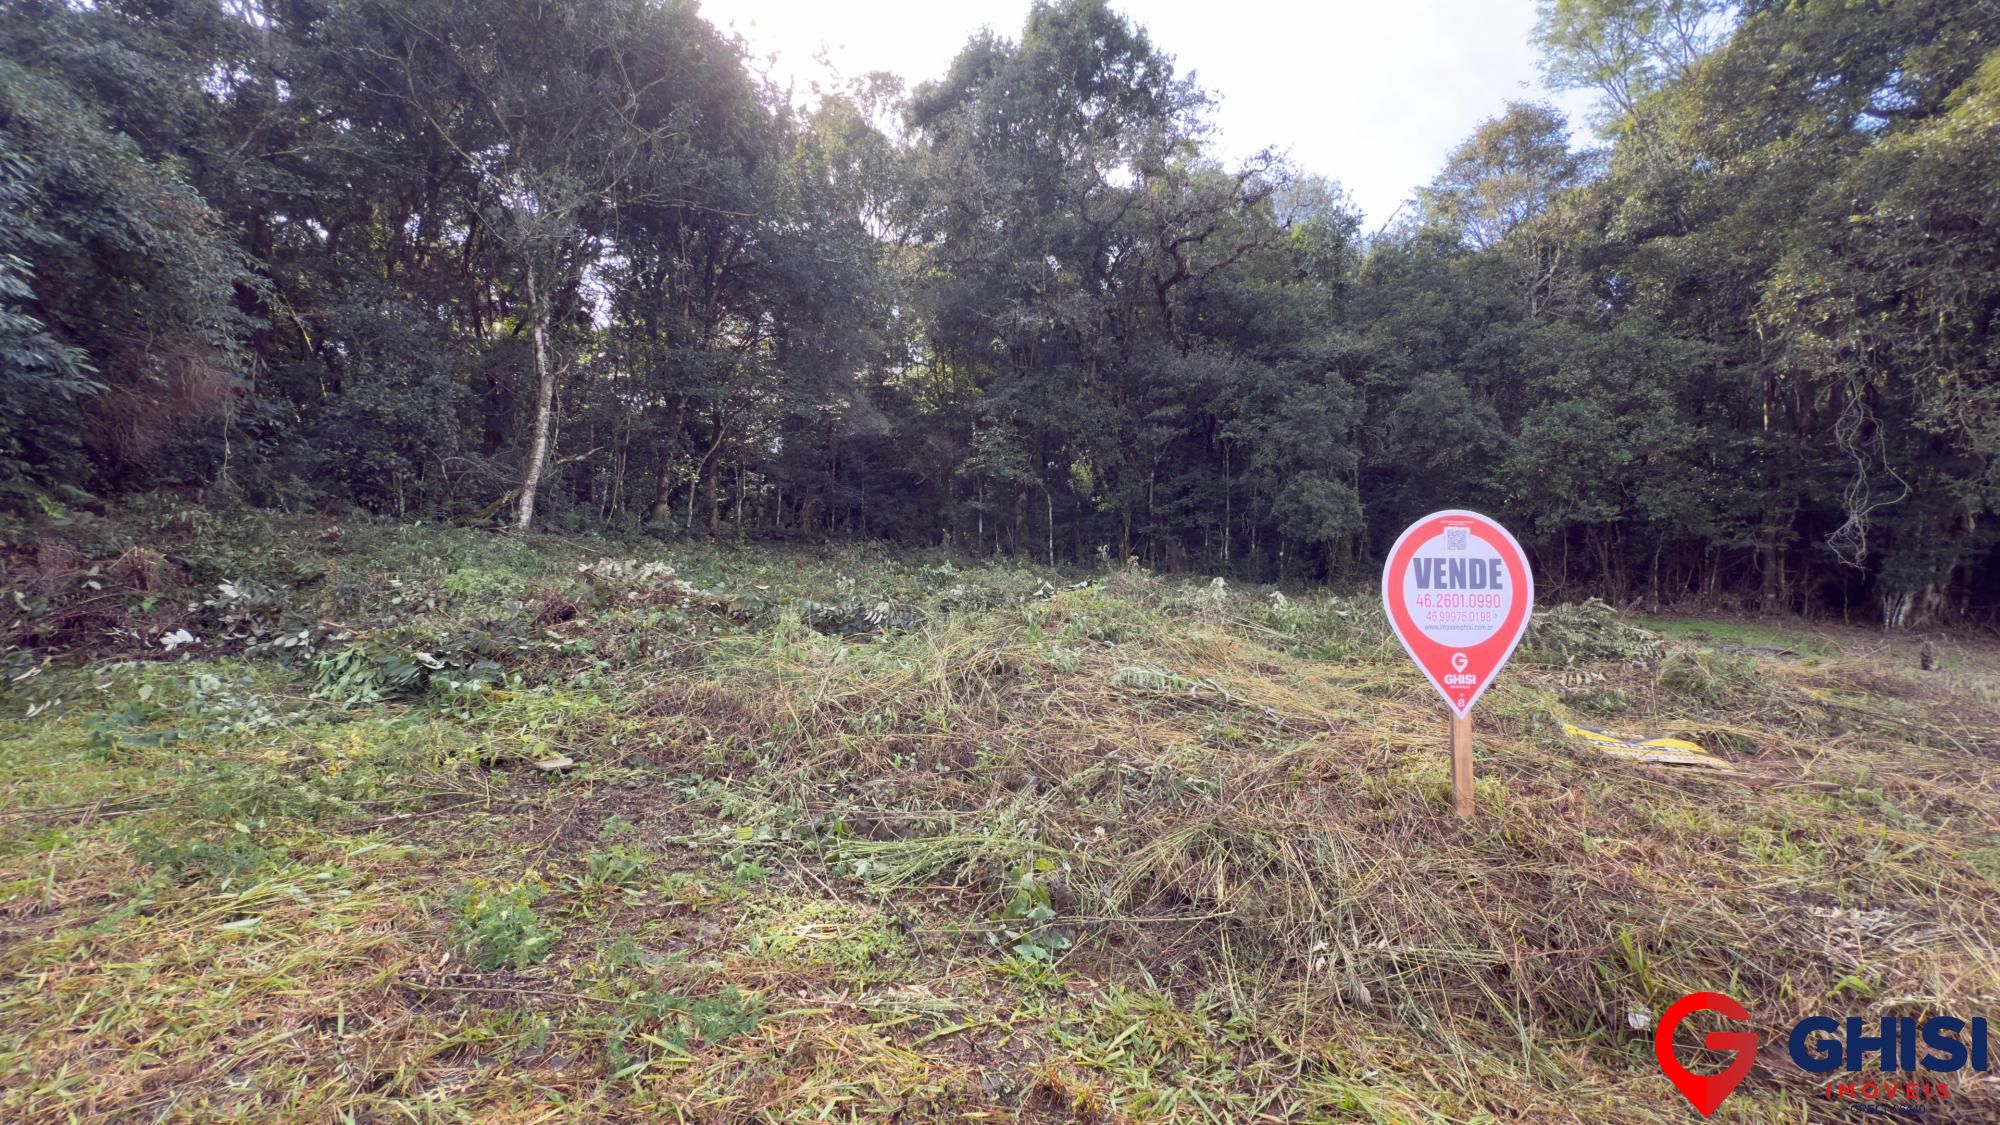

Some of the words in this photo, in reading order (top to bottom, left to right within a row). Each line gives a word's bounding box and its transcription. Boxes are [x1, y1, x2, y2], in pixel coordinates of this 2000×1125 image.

[1413, 557, 1503, 590] VENDE
[1416, 593, 1501, 609] 46.2601.0990
[1444, 674, 1477, 685] GHISI
